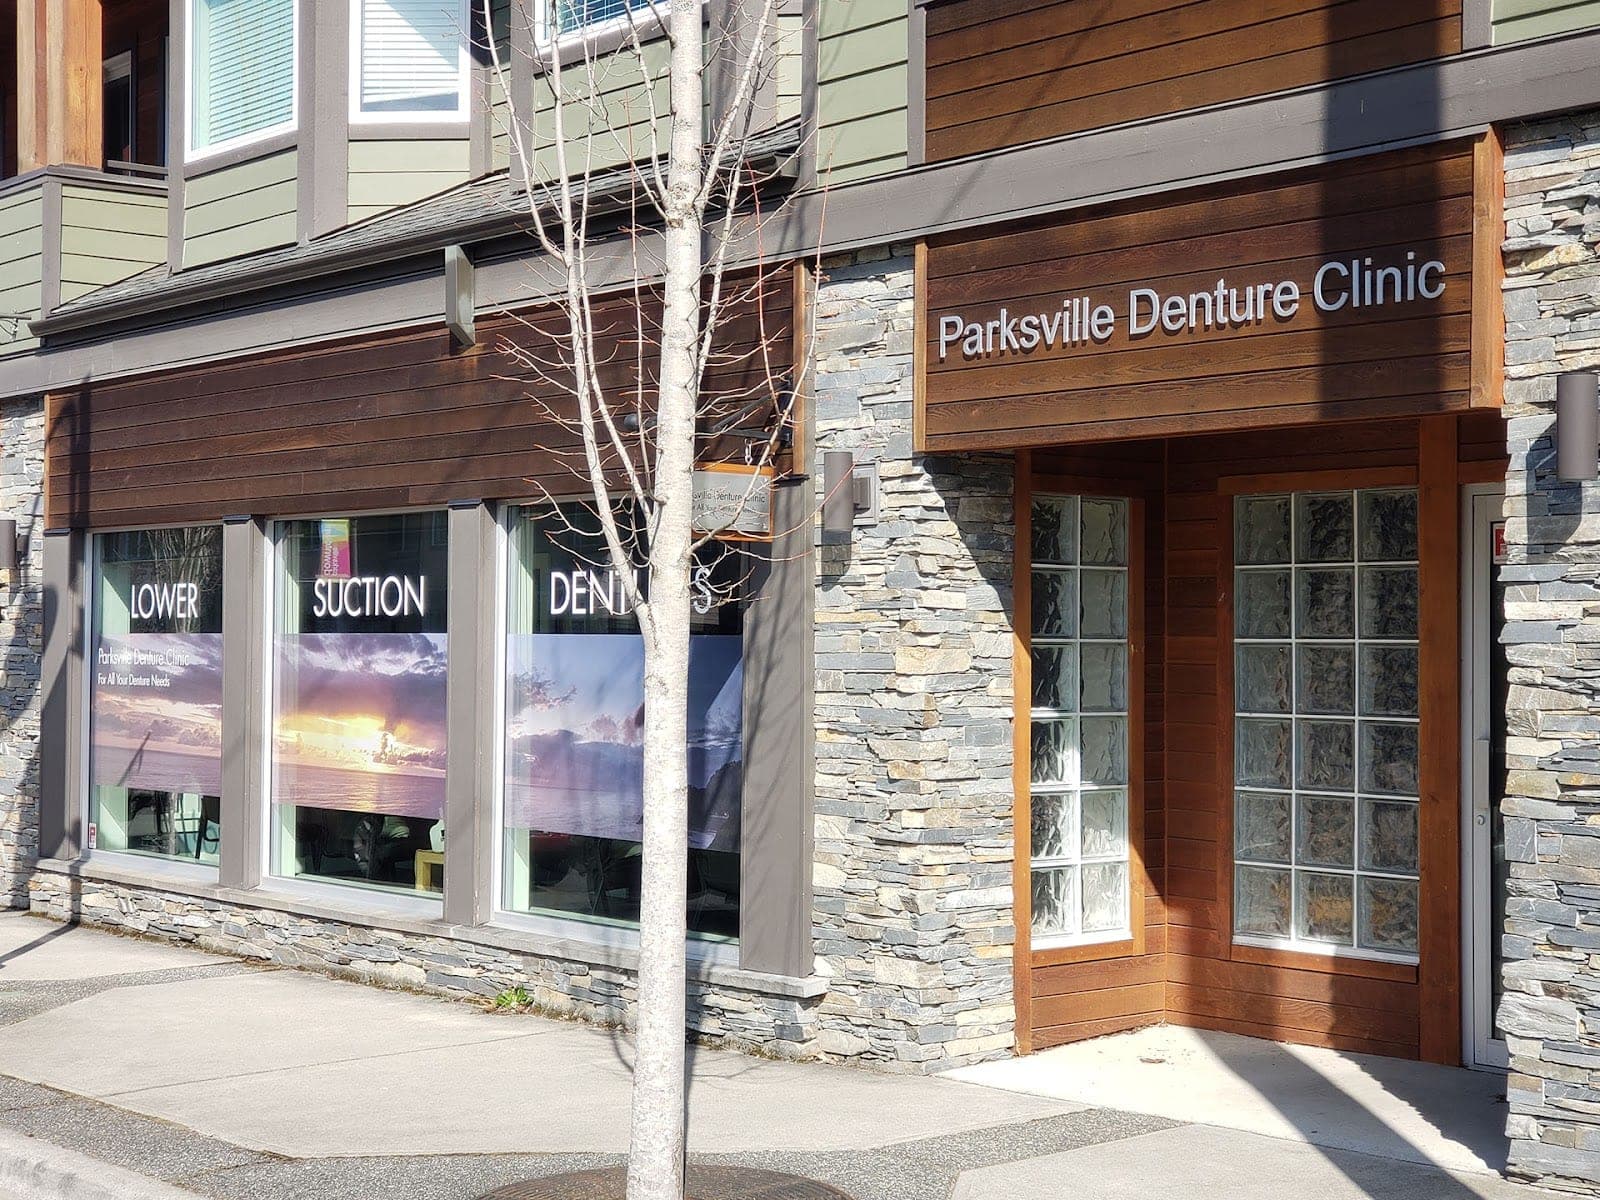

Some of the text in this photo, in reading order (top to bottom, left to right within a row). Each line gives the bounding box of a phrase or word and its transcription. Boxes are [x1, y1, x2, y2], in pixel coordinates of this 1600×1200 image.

[939, 251, 1446, 358] Parksville Denture Clinic
[131, 582, 199, 619] LOWER
[313, 575, 425, 617] SUCTION
[550, 567, 712, 615] DENTS
[98, 646, 190, 666] Parksville Denture Clinic
[98, 672, 171, 688] For All Your Denture Needs
